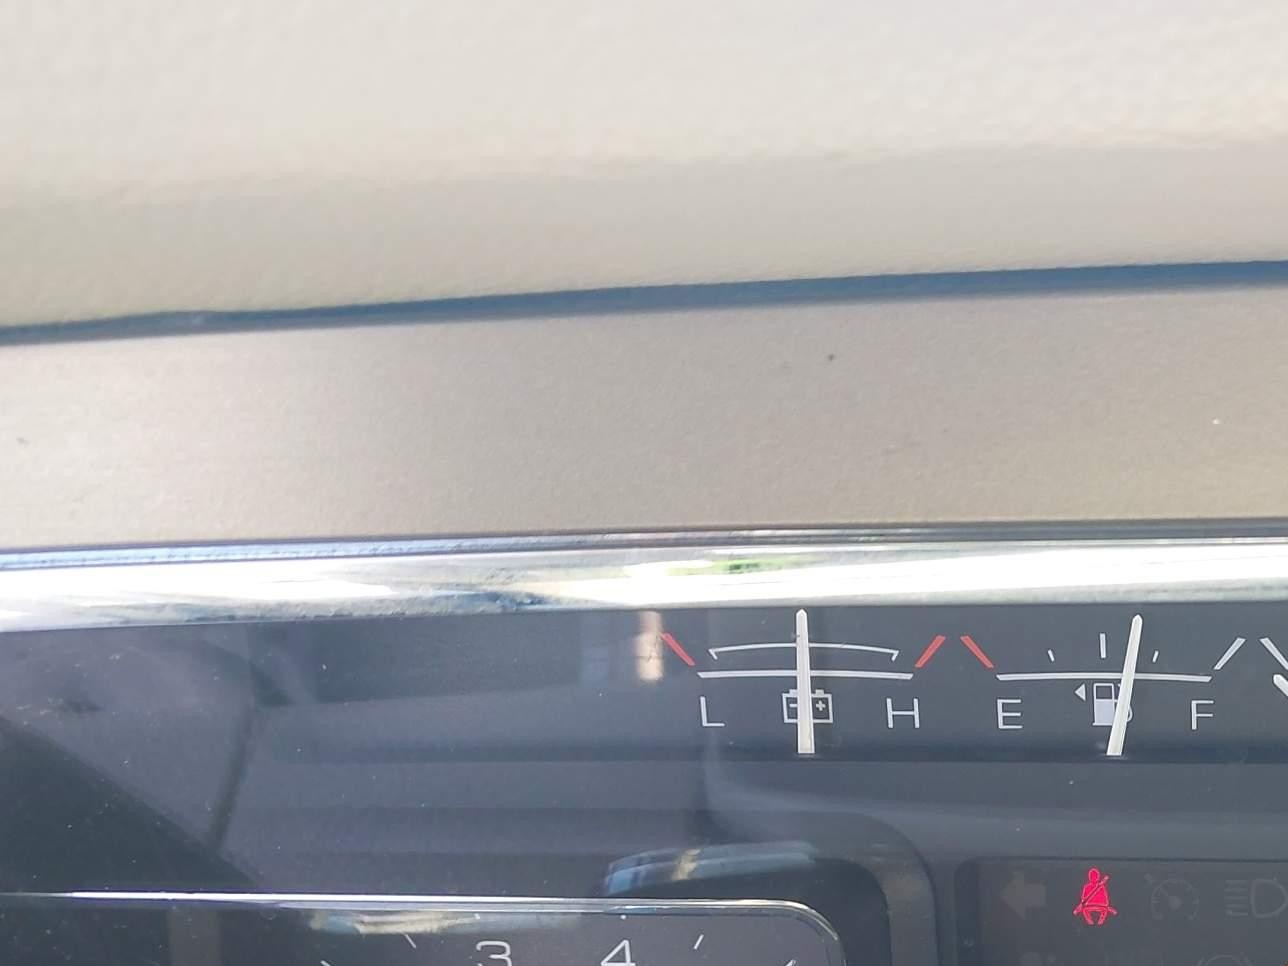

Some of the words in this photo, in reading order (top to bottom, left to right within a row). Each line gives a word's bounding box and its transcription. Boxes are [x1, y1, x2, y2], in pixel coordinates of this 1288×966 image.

[699, 696, 725, 727] L
[886, 697, 920, 729] H
[996, 698, 1023, 729] E
[1191, 699, 1214, 730] F
